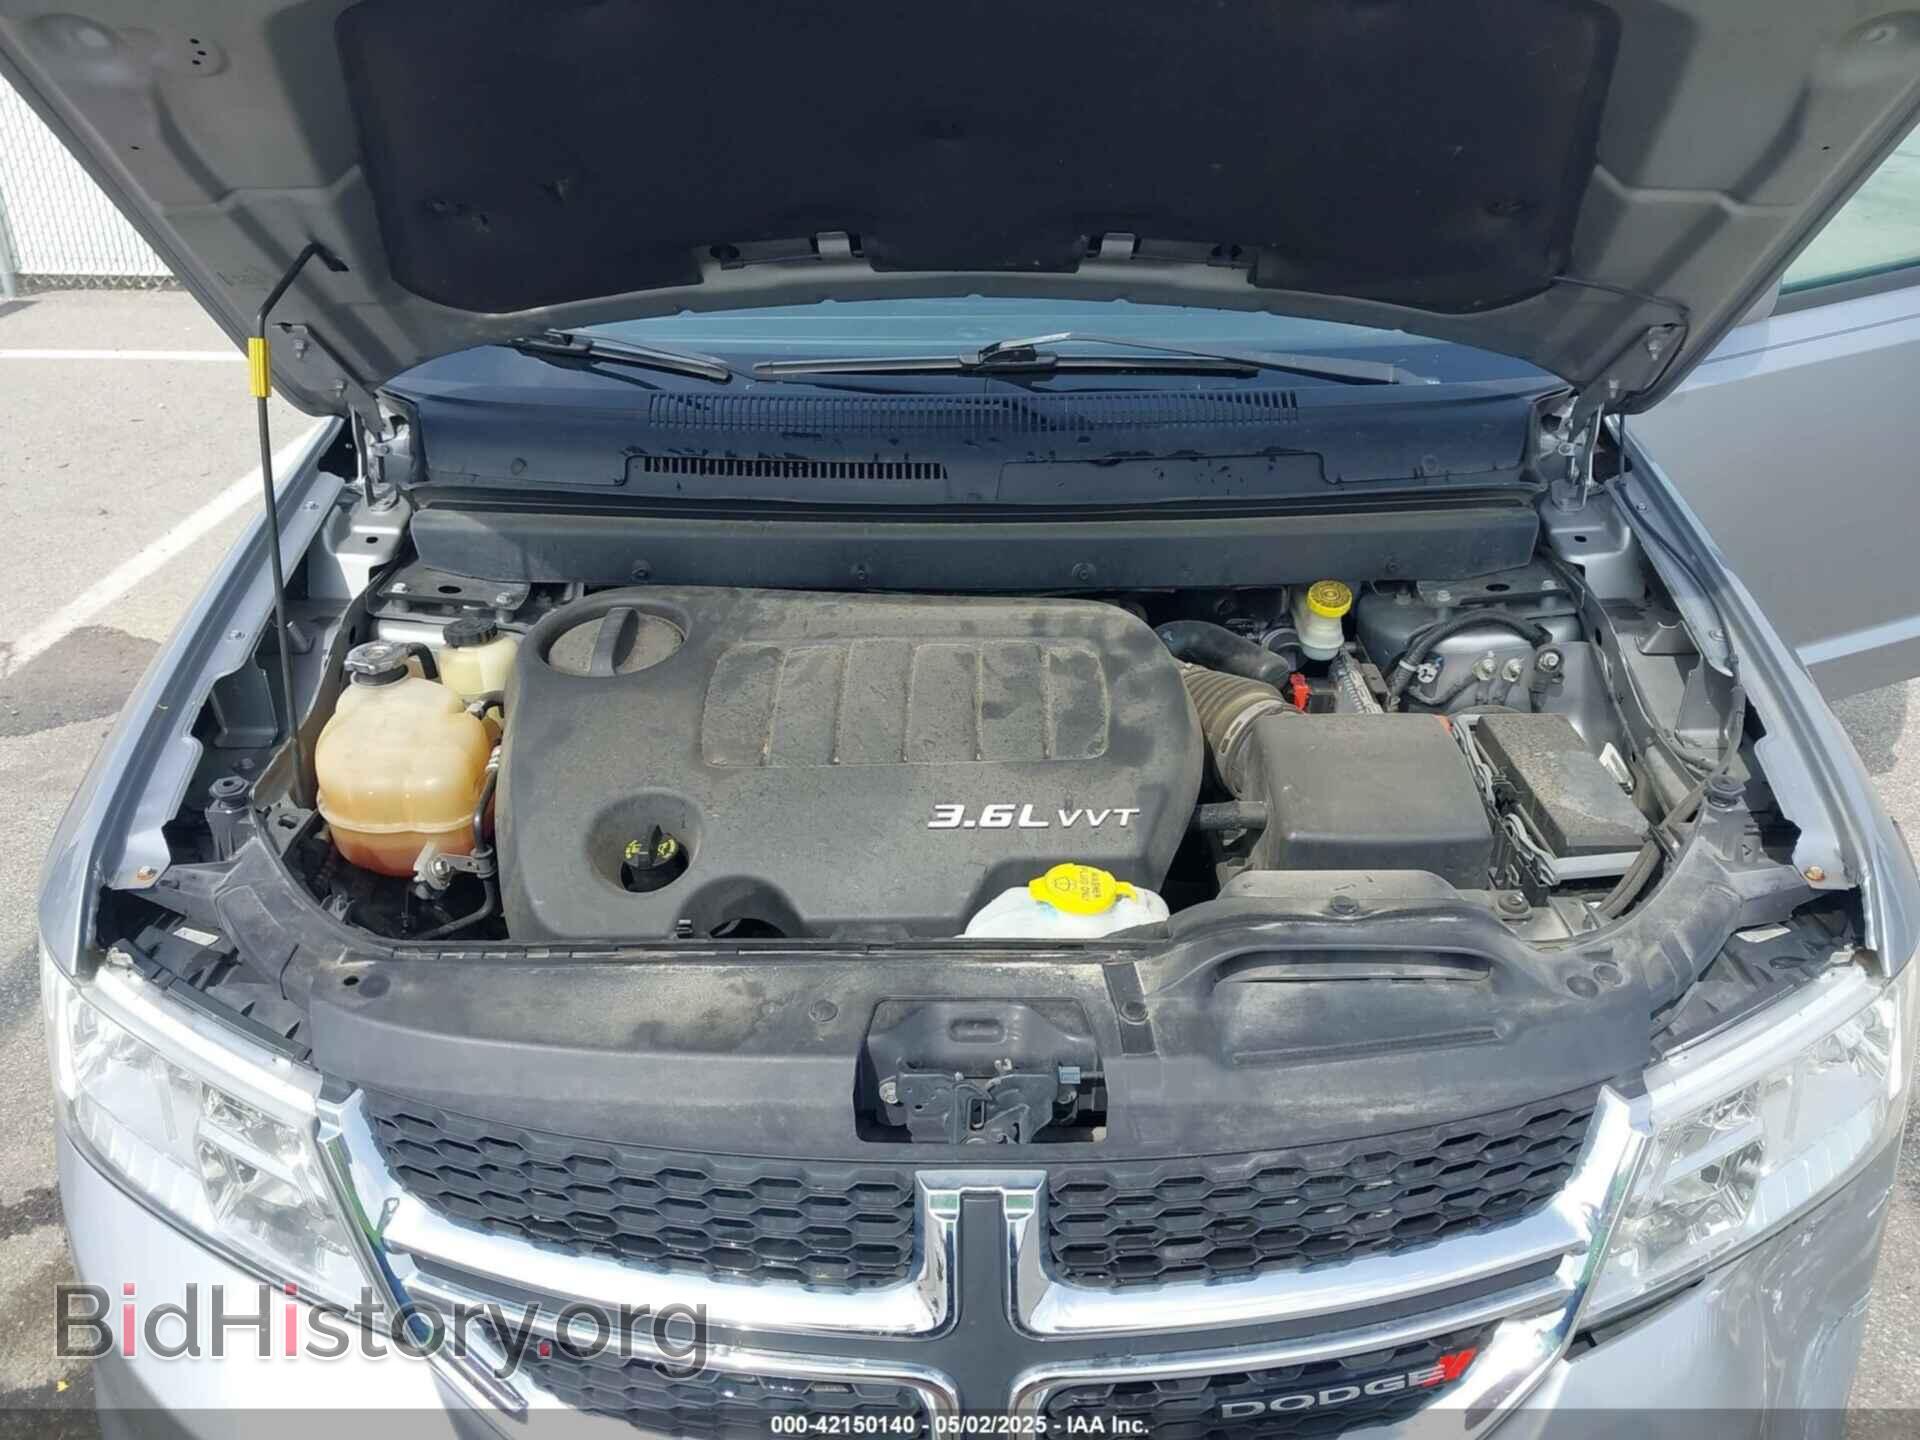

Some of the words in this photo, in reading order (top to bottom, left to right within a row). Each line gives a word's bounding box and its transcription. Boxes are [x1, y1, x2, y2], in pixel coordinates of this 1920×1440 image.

[927, 803, 1050, 829] 3.6L
[1057, 807, 1141, 828] VVT
[1221, 1364, 1445, 1418] DODGE
